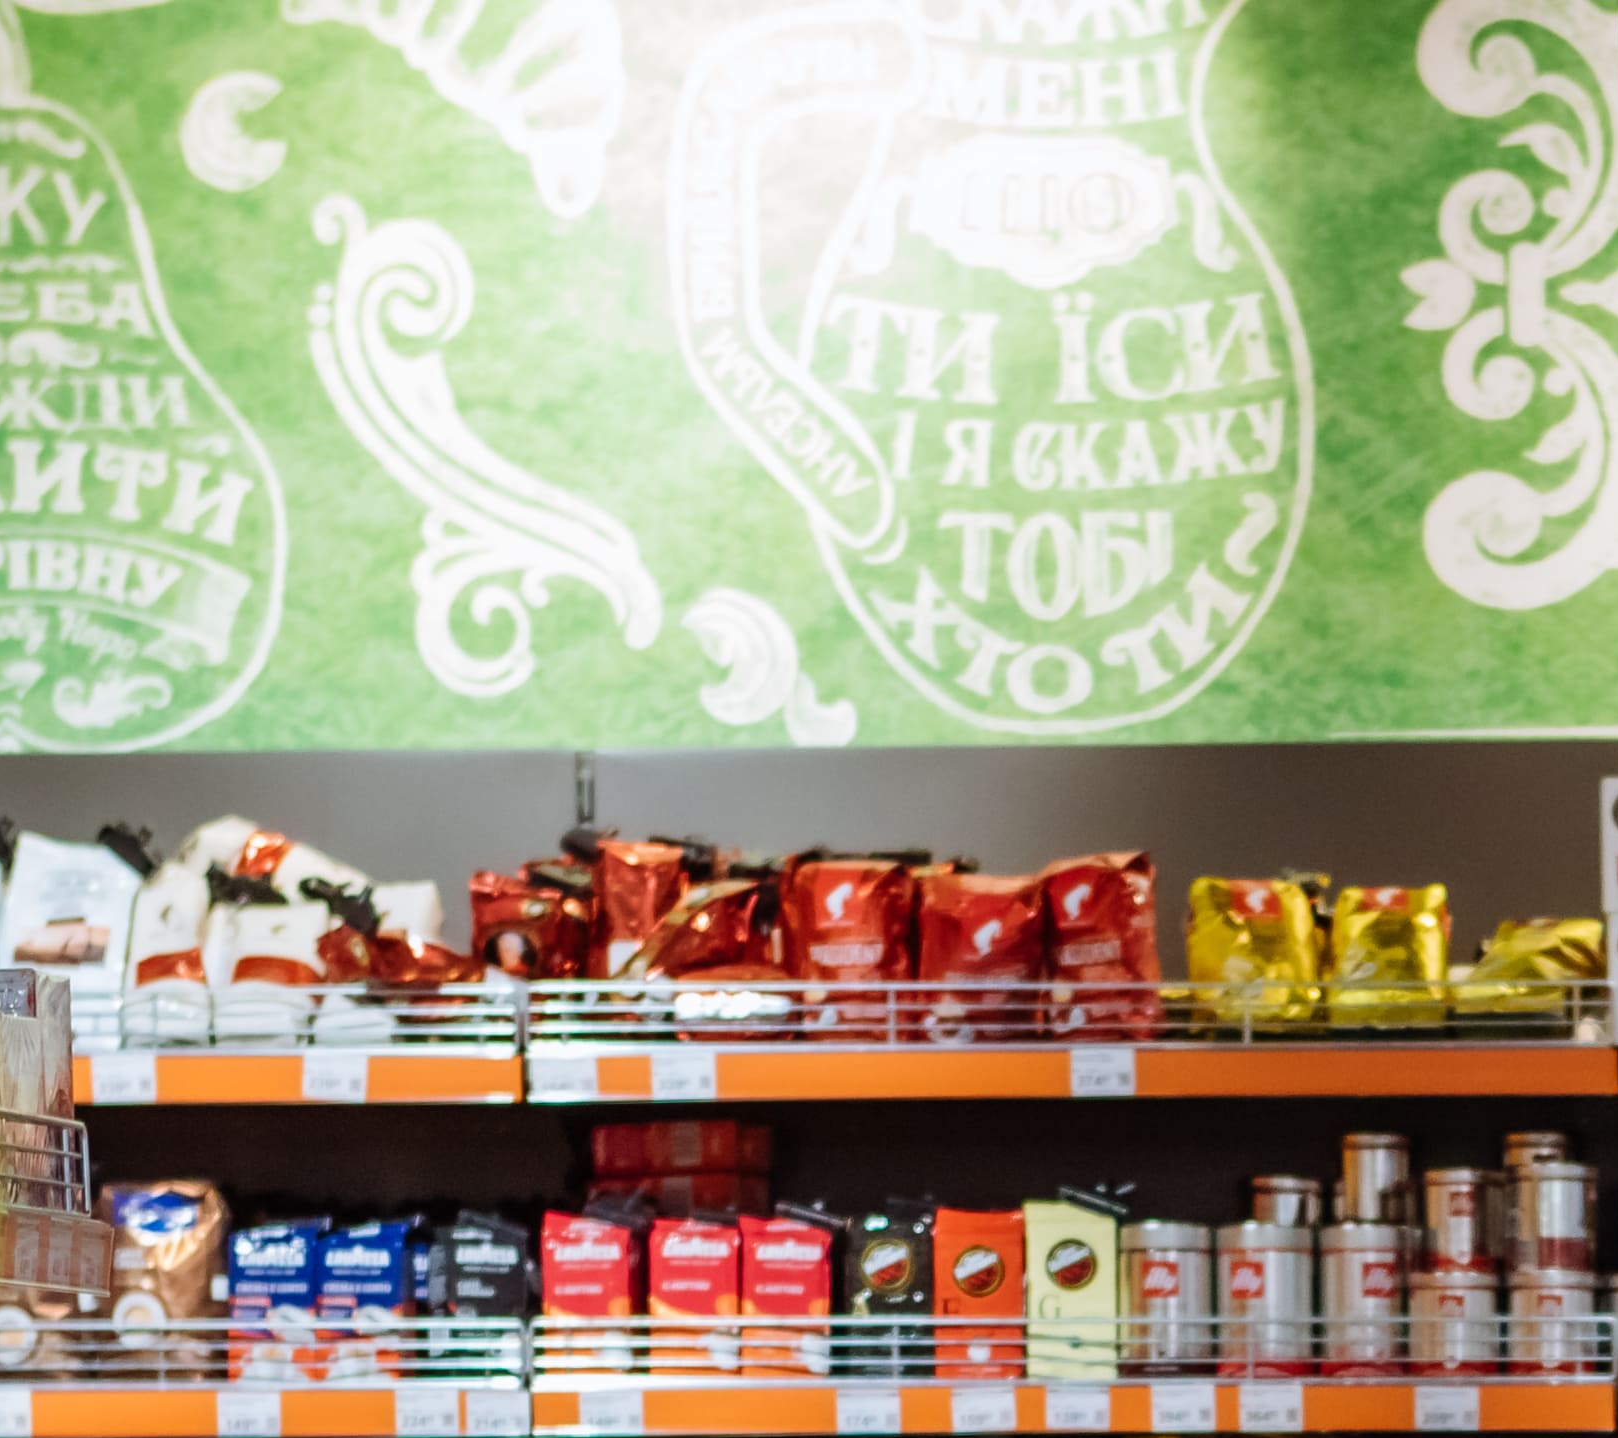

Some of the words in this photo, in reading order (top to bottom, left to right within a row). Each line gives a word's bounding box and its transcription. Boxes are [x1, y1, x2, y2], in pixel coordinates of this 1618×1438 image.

[923, 49, 1187, 126] МЕНІ
[828, 294, 999, 404] ТИ
[1054, 291, 1284, 404] ЇСИ
[941, 419, 994, 488] Я
[1011, 399, 1283, 492] СКАЖУ
[938, 511, 1175, 621] ТОБІ
[868, 564, 1094, 715] ХТО
[1101, 561, 1255, 696] ТИ
